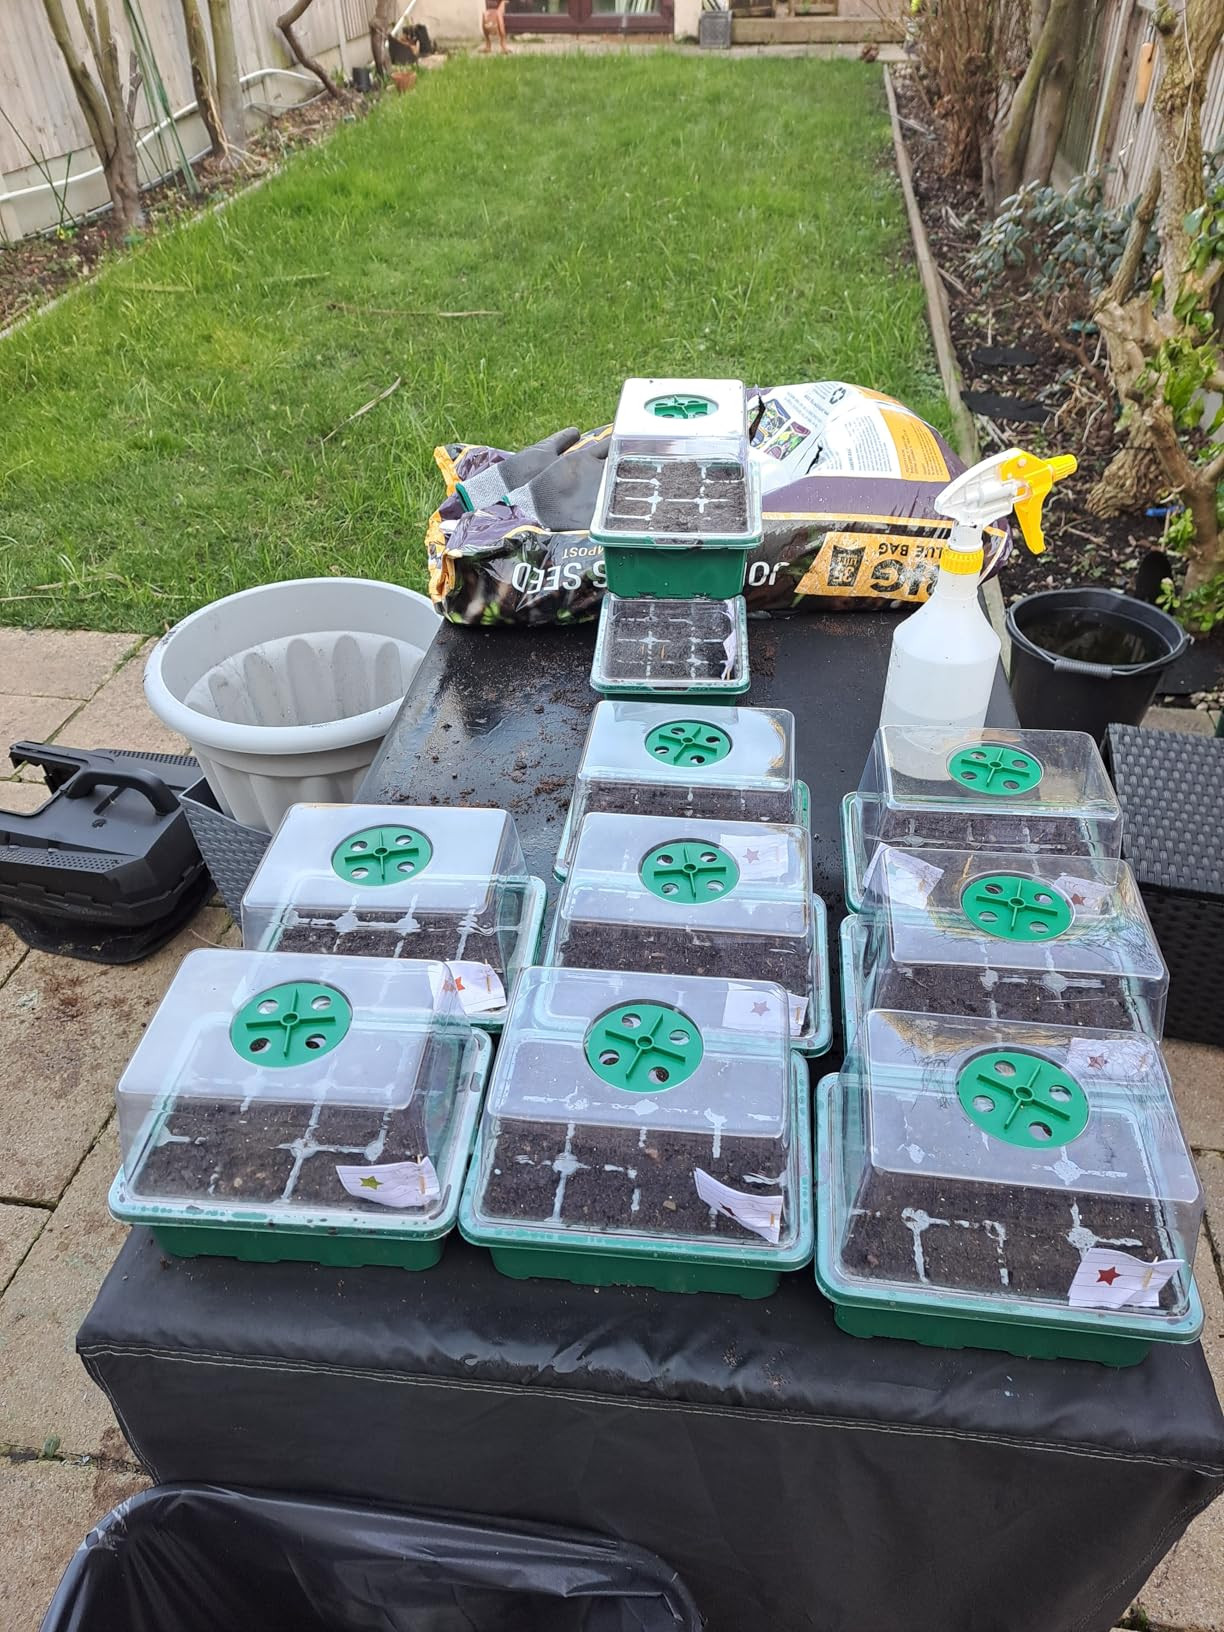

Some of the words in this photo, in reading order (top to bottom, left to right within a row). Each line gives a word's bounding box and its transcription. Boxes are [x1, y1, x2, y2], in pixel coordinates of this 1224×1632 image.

[879, 543, 909, 557] BAG
[915, 545, 943, 559] LUE
[511, 562, 582, 595] SEED
[743, 561, 790, 587] JO
